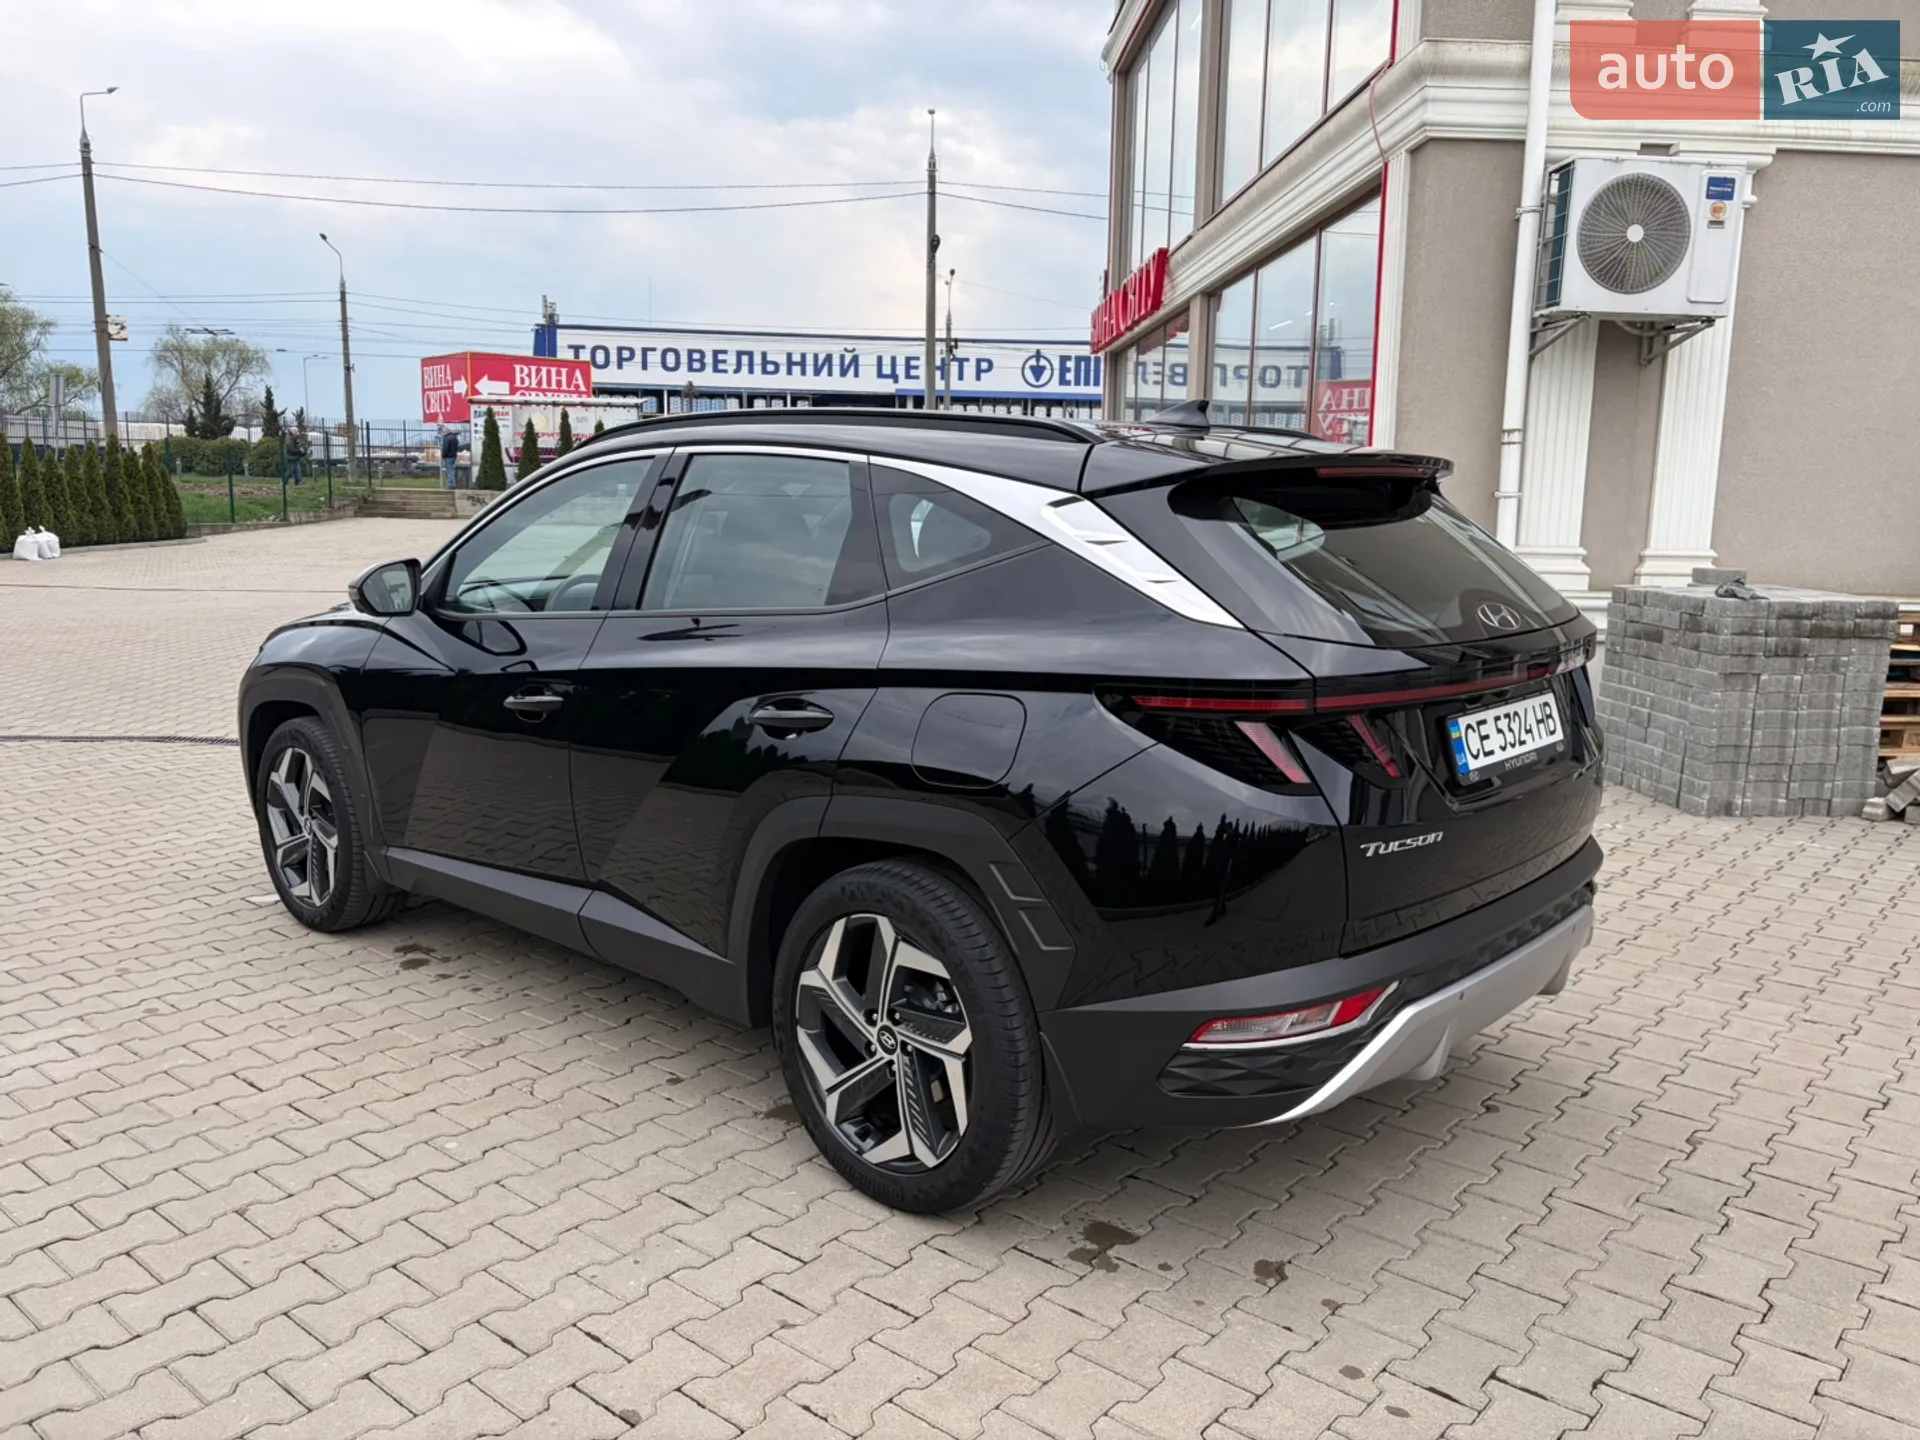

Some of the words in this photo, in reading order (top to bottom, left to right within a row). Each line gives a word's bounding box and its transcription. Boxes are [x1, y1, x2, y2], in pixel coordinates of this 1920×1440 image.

[567, 344, 860, 379] ТОРГОВЕЛЬНИЙ
[423, 364, 452, 389] ВИНА
[513, 364, 588, 391] ВИНА
[423, 390, 453, 414] СВІТУ
[1464, 719, 1495, 760] CE
[1493, 707, 1535, 752] 5324
[1532, 701, 1556, 740] HB
[1504, 752, 1538, 770] HYUNDAI
